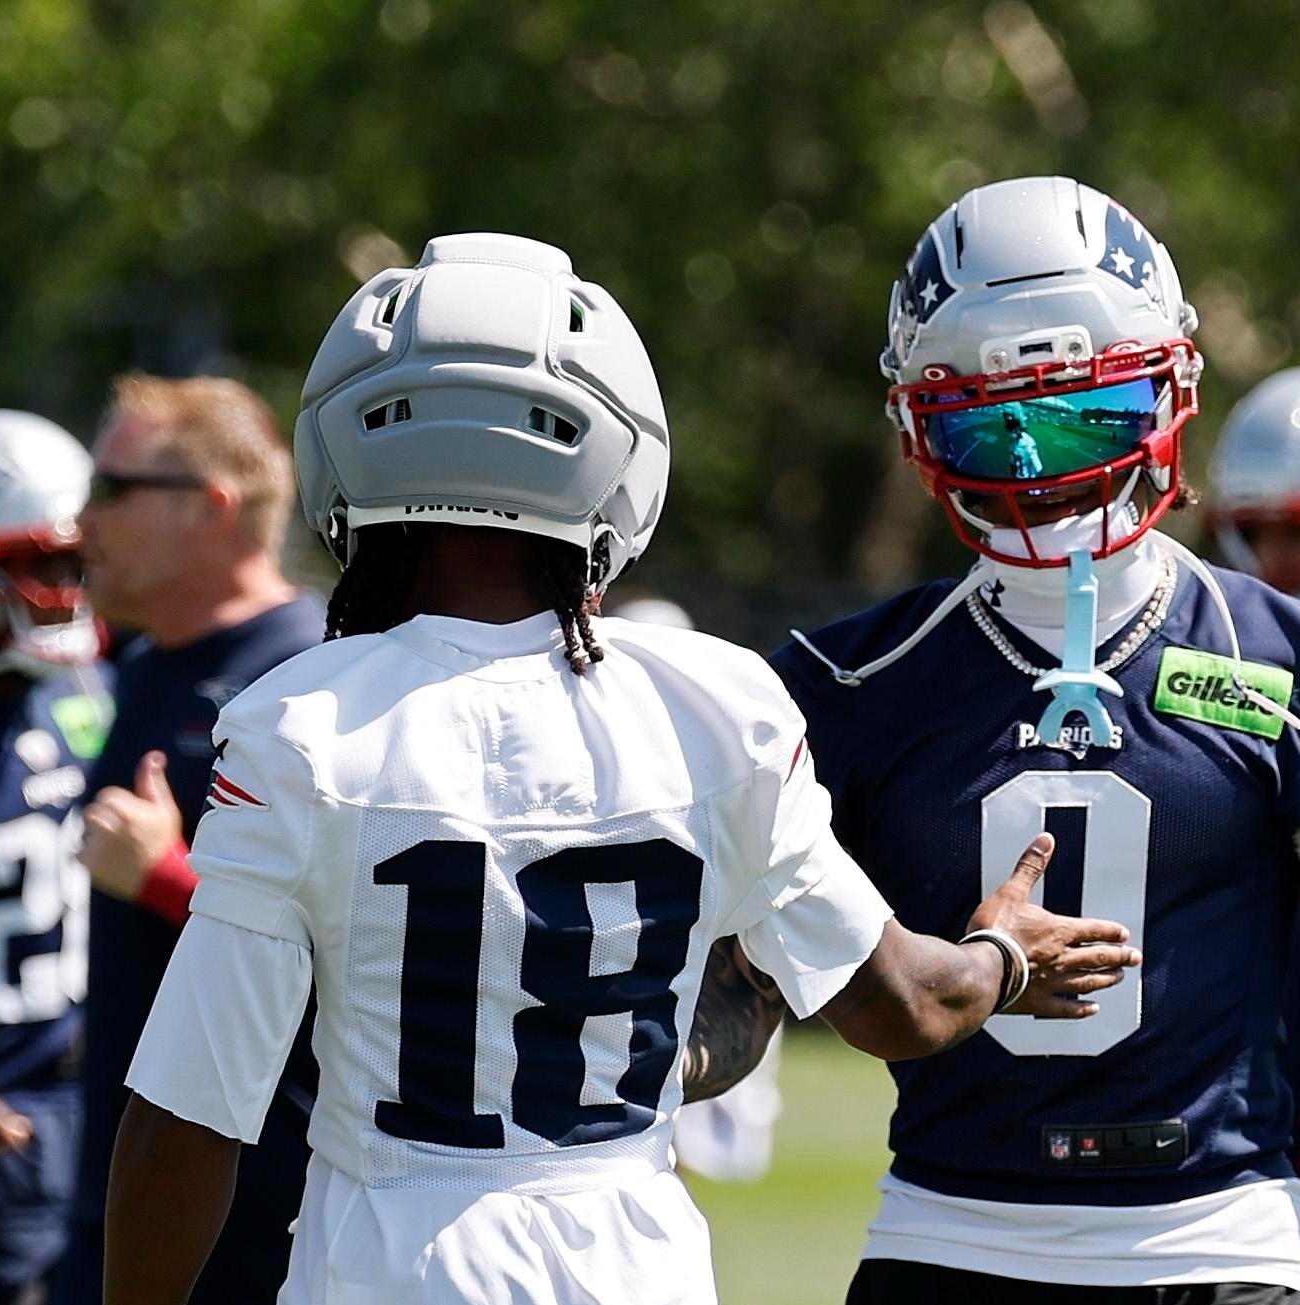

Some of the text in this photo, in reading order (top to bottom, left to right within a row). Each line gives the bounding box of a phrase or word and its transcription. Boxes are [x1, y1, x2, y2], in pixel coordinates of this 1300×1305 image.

[1019, 723, 1123, 750] PRIOS
[373, 838, 705, 1150] 18
[981, 770, 1152, 1057] 0
